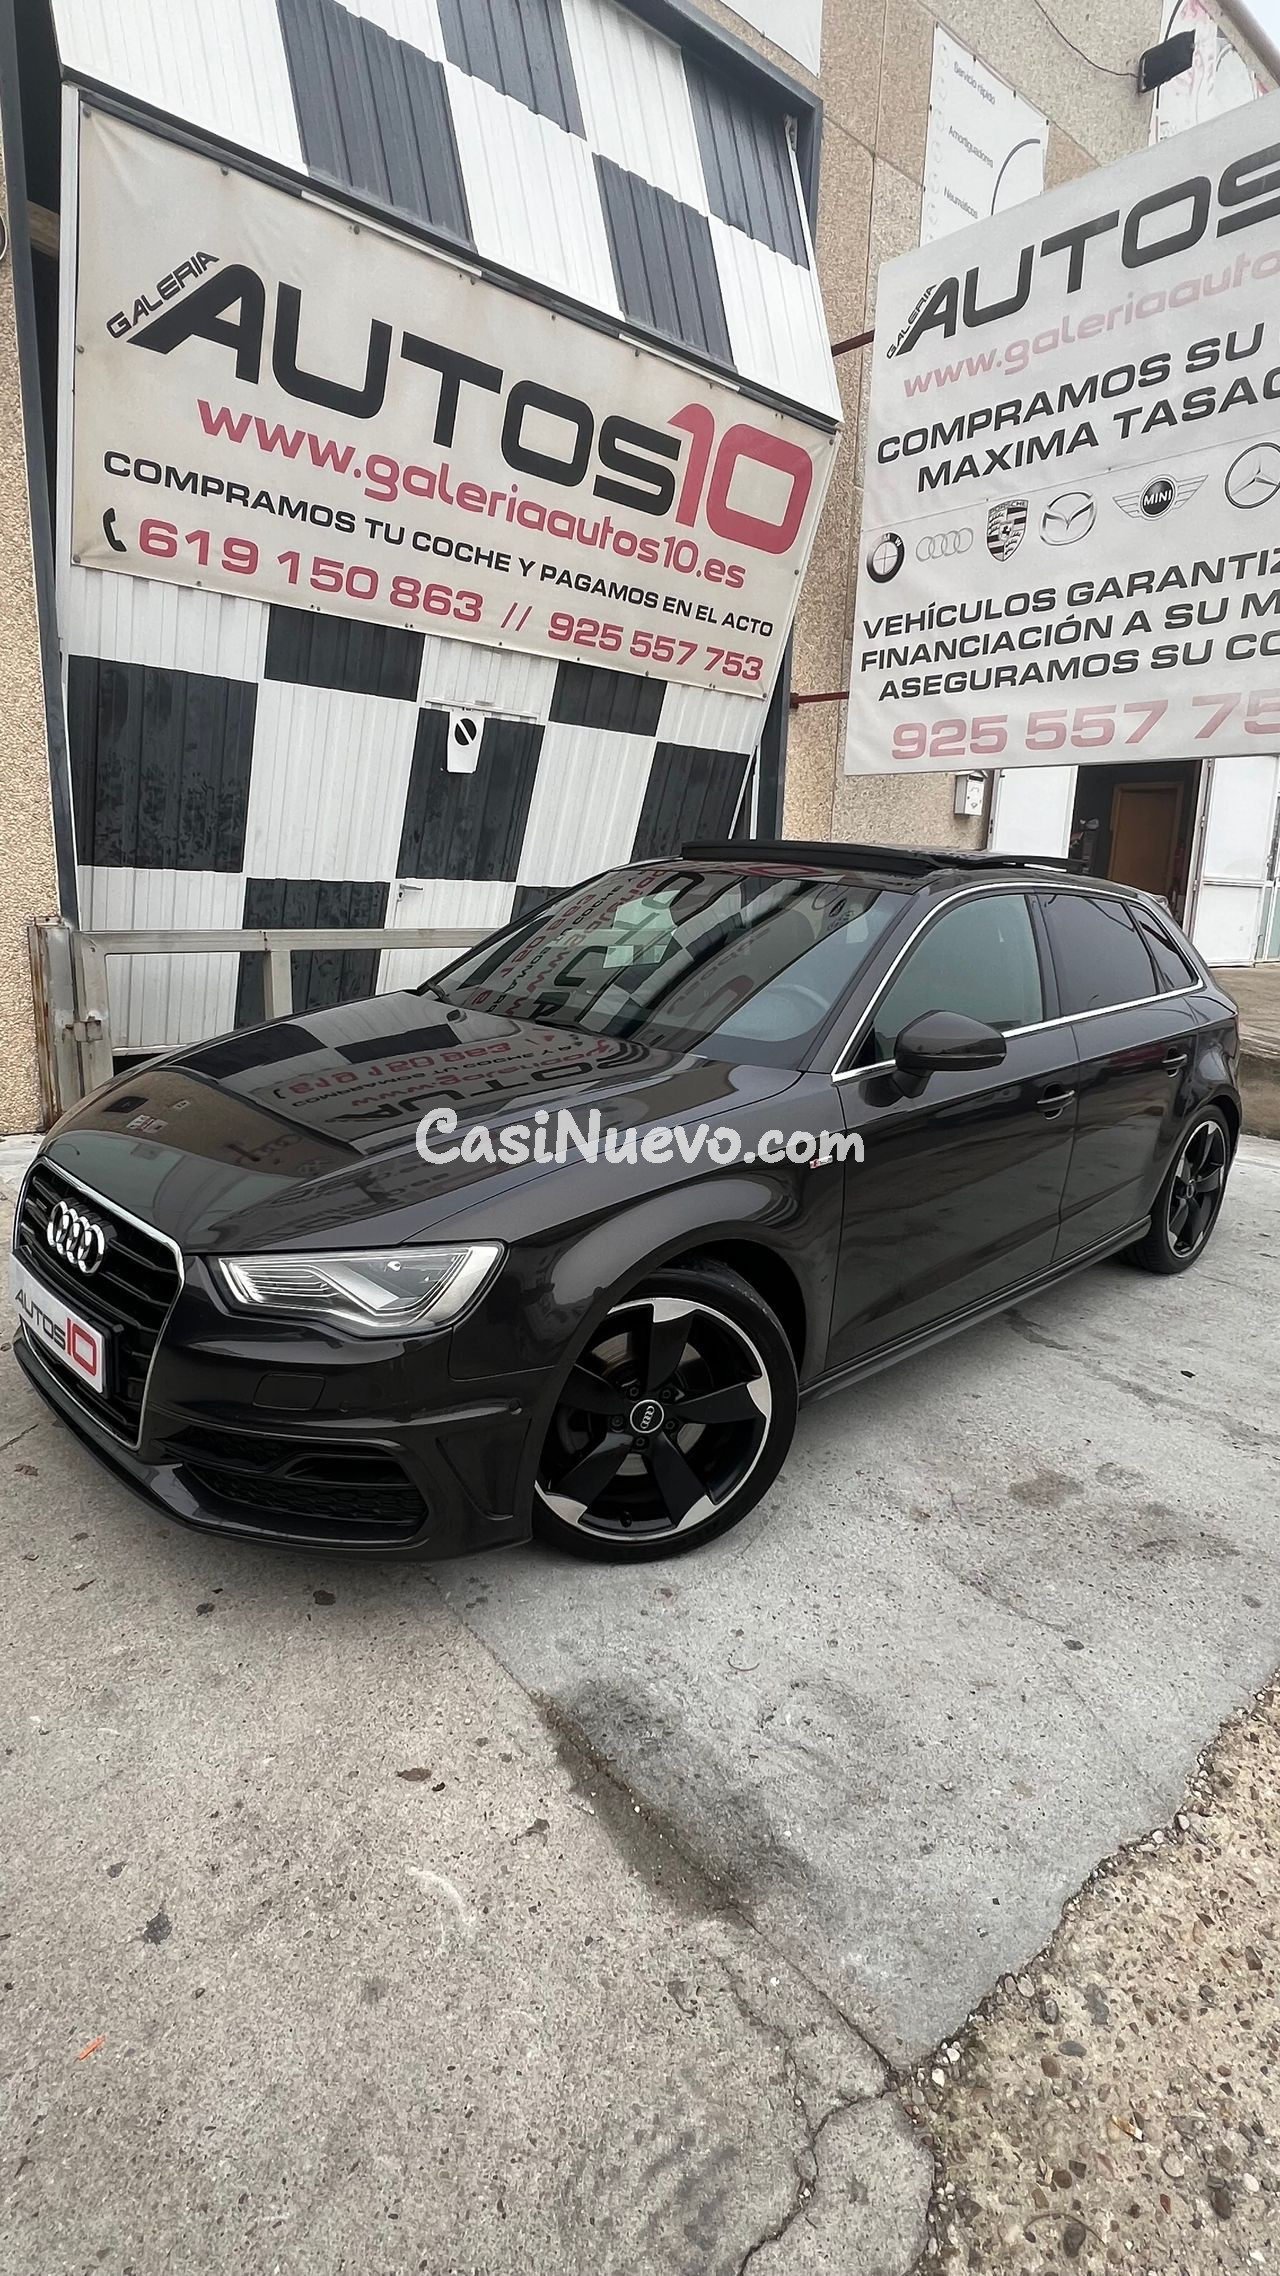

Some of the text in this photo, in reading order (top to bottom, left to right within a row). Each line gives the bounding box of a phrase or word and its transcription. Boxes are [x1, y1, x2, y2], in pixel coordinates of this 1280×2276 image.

[106, 250, 219, 340] GALERIA
[886, 283, 938, 360] GALERIA
[877, 322, 1265, 464] COMPRAMOS SU
[197, 398, 746, 590] www.galeriaautos10.es
[917, 421, 1099, 493] MAXIMA
[1142, 488, 1173, 508] MINI
[103, 449, 774, 638] COMPRAMOS TU COCHE Y PAGAMOS EN EL ACTO
[138, 516, 261, 576] 619
[276, 548, 379, 602] 150
[388, 576, 484, 623] 863
[547, 611, 624, 654] 925
[629, 629, 698, 668] 557
[704, 646, 765, 682] 753
[860, 613, 1113, 673] FINANCIACIÓN
[1122, 609, 1153, 637] A
[1164, 597, 1230, 631] SU
[863, 548, 1280, 640] VEHÍCULOS GARANTI
[877, 649, 1140, 702] ASEGURAMOS
[1149, 639, 1214, 671] SU
[890, 713, 1008, 761] 925
[1025, 699, 1170, 752] 557
[15, 1288, 97, 1378] AUTOS10
